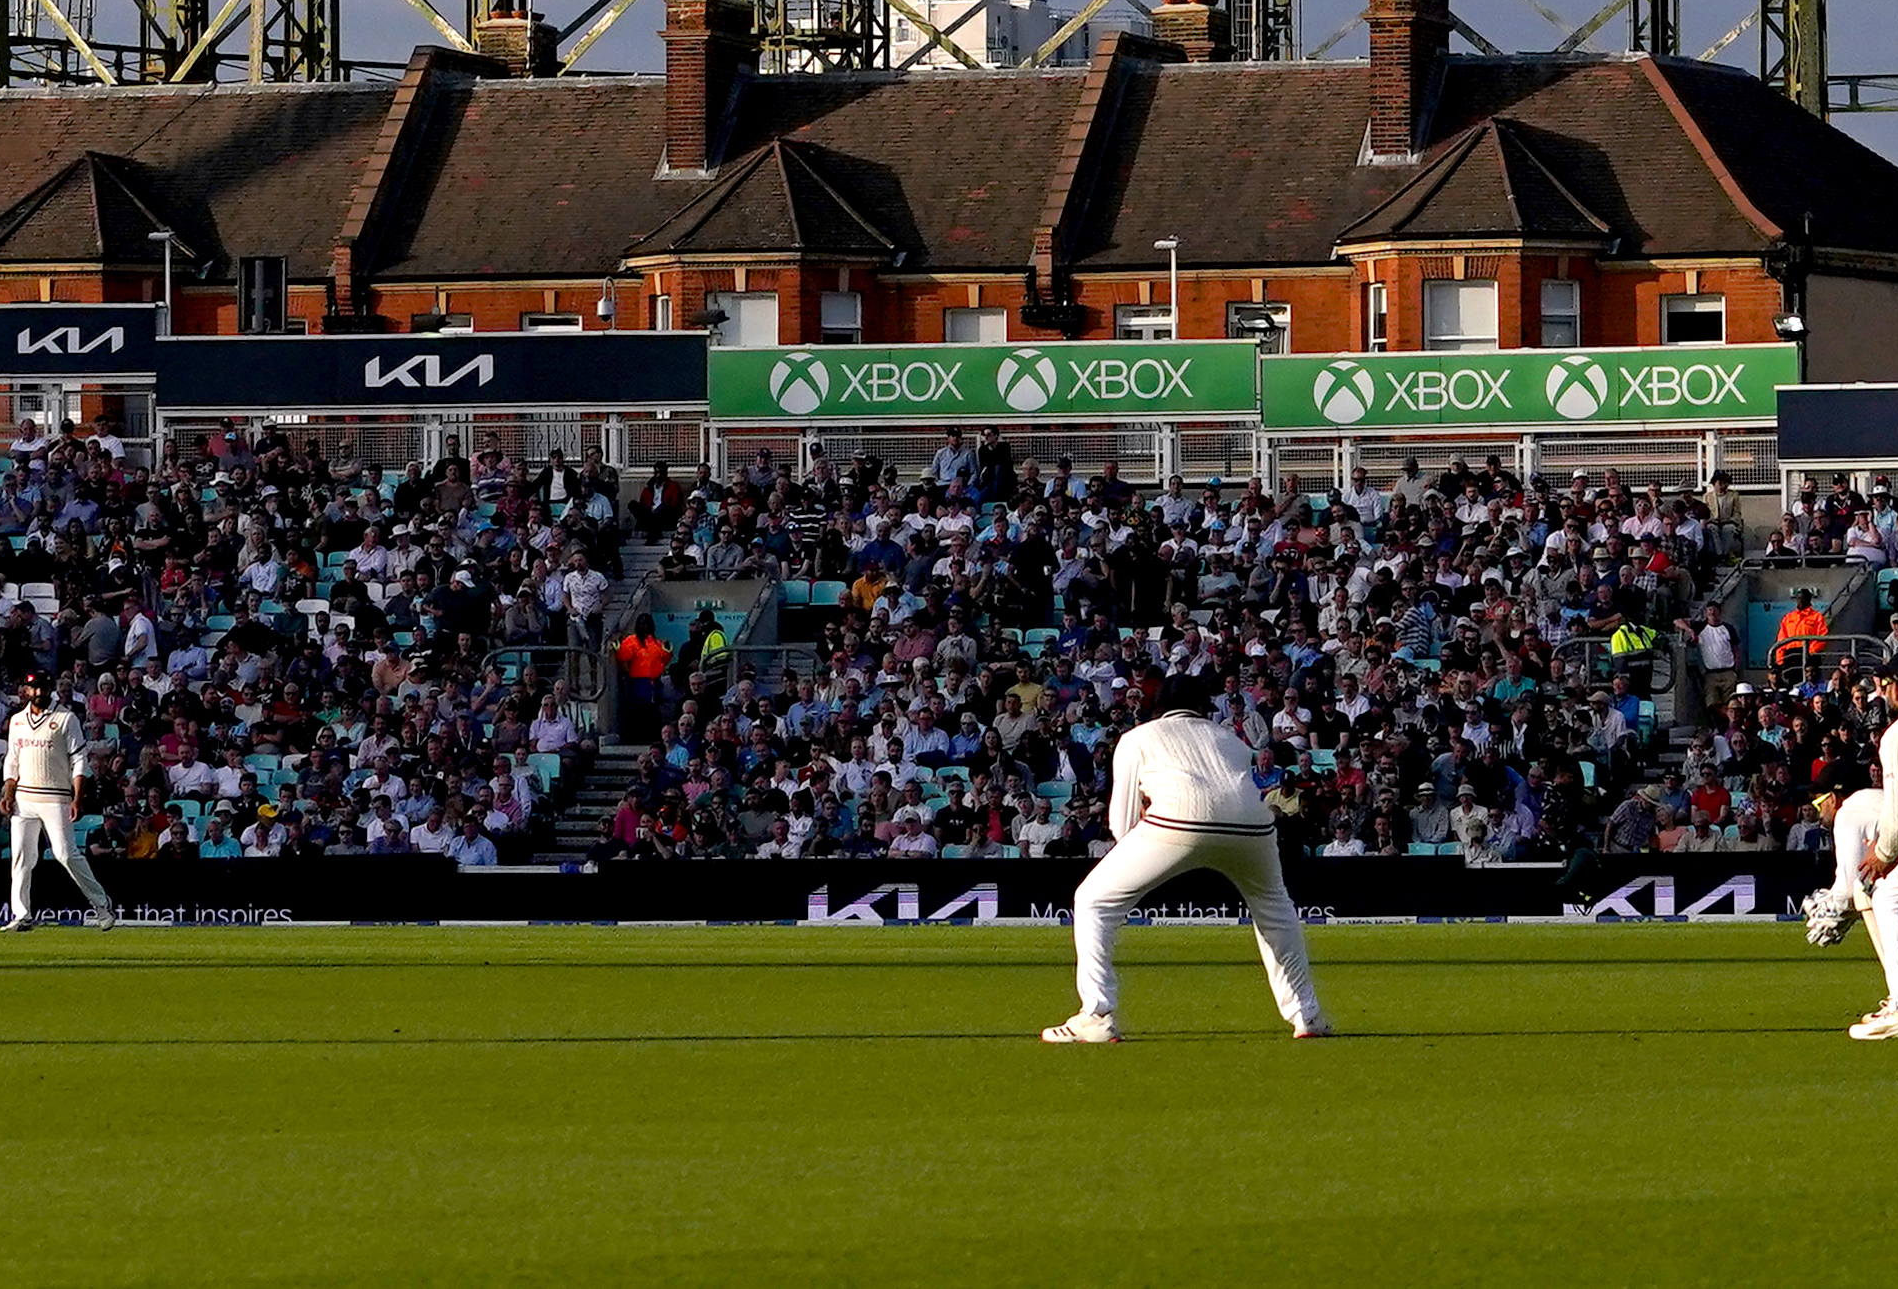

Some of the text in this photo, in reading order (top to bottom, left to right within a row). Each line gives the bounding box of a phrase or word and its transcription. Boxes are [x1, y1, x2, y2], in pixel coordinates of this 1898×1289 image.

[17, 326, 125, 355] KIA
[364, 354, 494, 388] KIA
[839, 361, 965, 403] XBOX
[1067, 358, 1195, 399] XBOX
[1385, 368, 1514, 412] XBOX
[1618, 363, 1747, 407] XBOX
[132, 902, 187, 922] that
[194, 902, 293, 922] inspires
[807, 882, 999, 920] KIA
[1176, 900, 1230, 919] that
